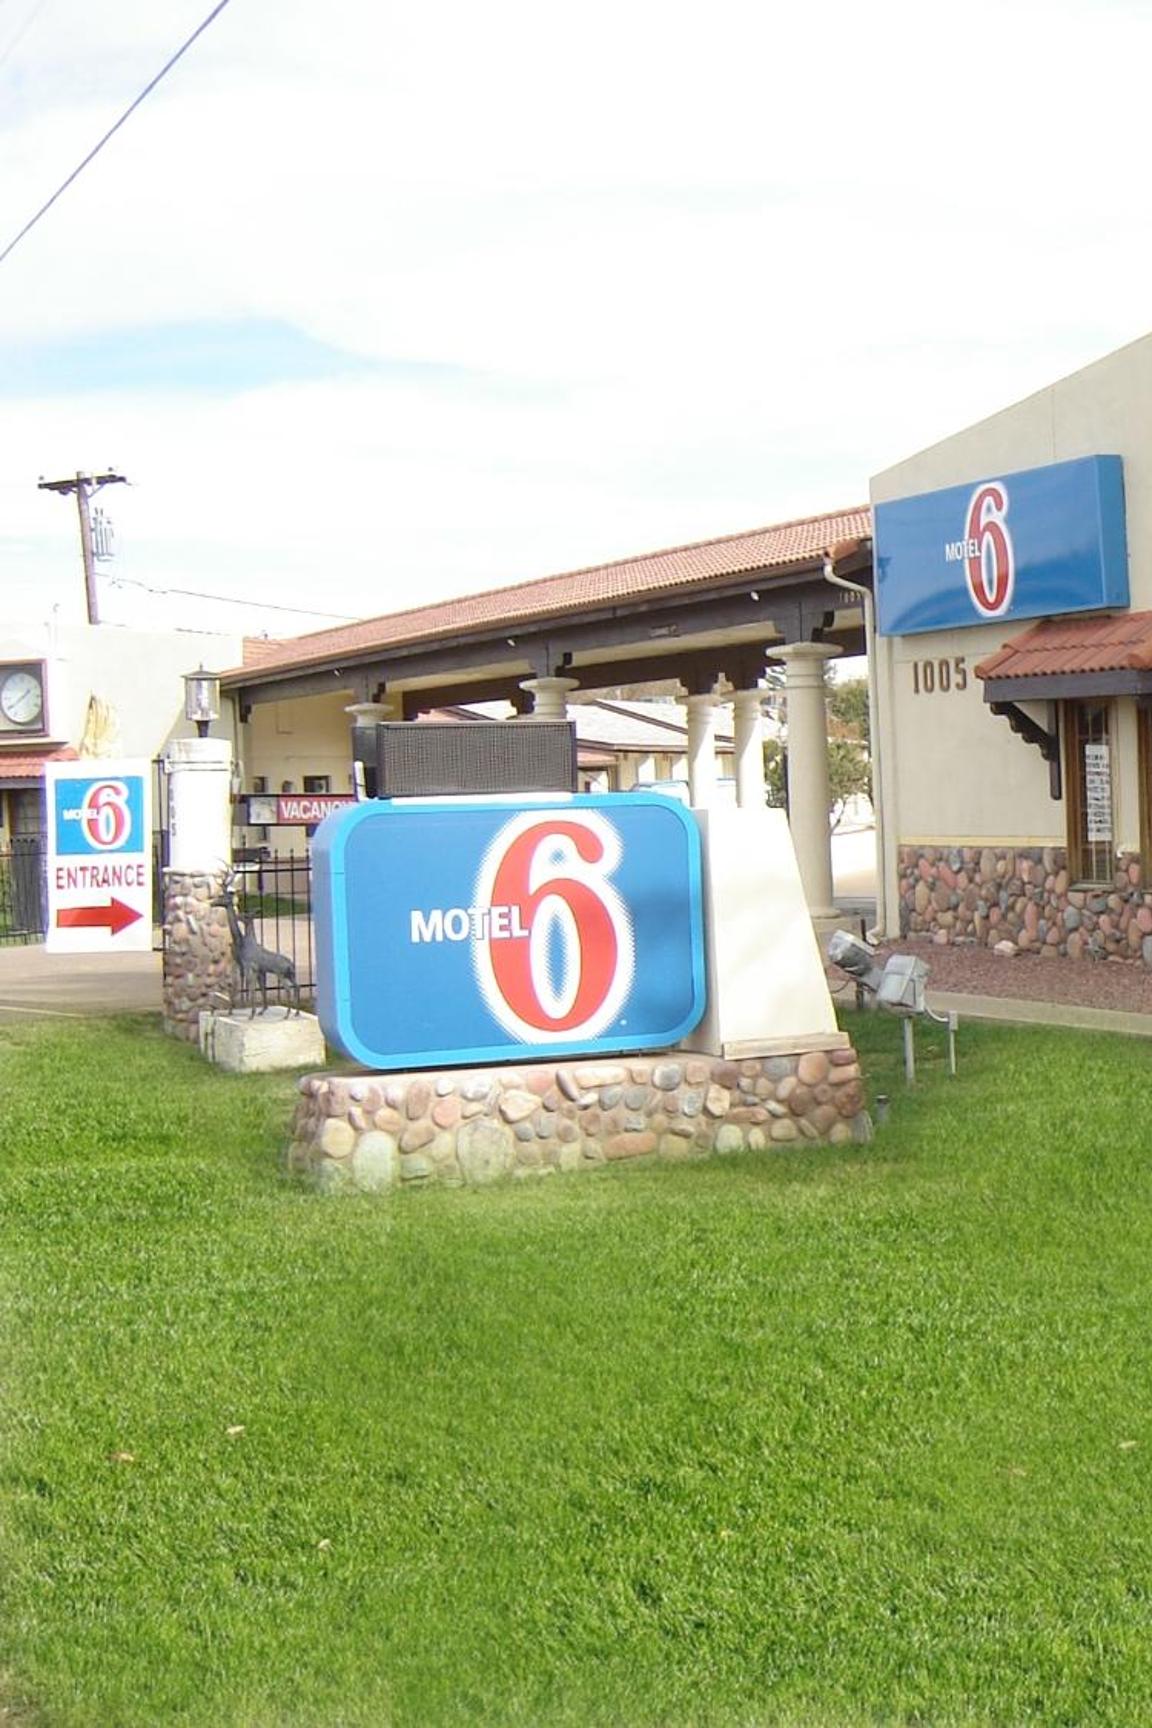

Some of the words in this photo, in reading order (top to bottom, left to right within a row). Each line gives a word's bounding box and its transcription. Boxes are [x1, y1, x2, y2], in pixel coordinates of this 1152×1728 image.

[945, 539, 981, 562] MOTEL
[968, 487, 1010, 612] 6
[913, 656, 967, 694] 1005
[86, 784, 125, 847] 6
[281, 801, 354, 819] VACAN
[56, 864, 145, 890] ENTRANCE
[410, 904, 530, 943] MOTEL
[490, 819, 618, 1033] 6
